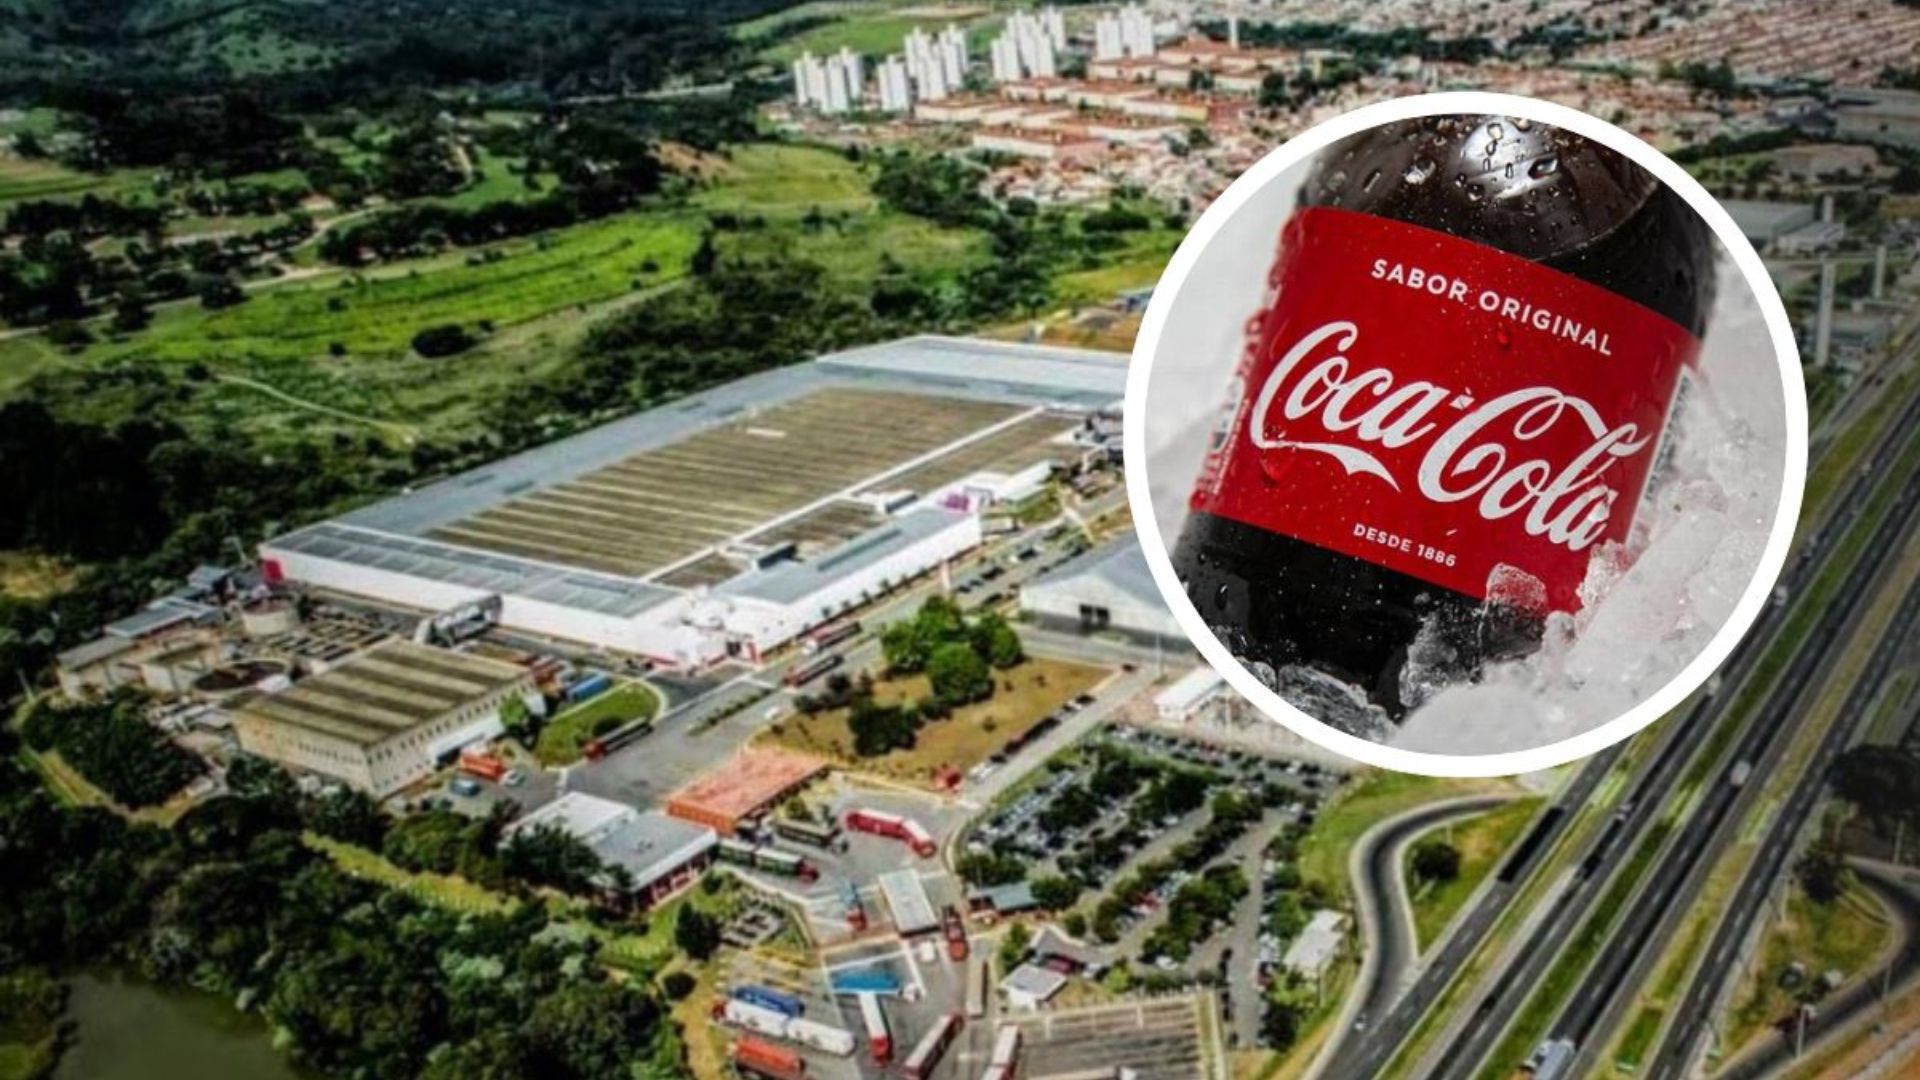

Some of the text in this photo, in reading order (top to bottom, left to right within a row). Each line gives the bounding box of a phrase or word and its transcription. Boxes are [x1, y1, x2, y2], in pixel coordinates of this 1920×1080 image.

[1371, 259, 1612, 355] SABOR ORIGINAL
[1353, 523, 1457, 567] DESDE 1886
